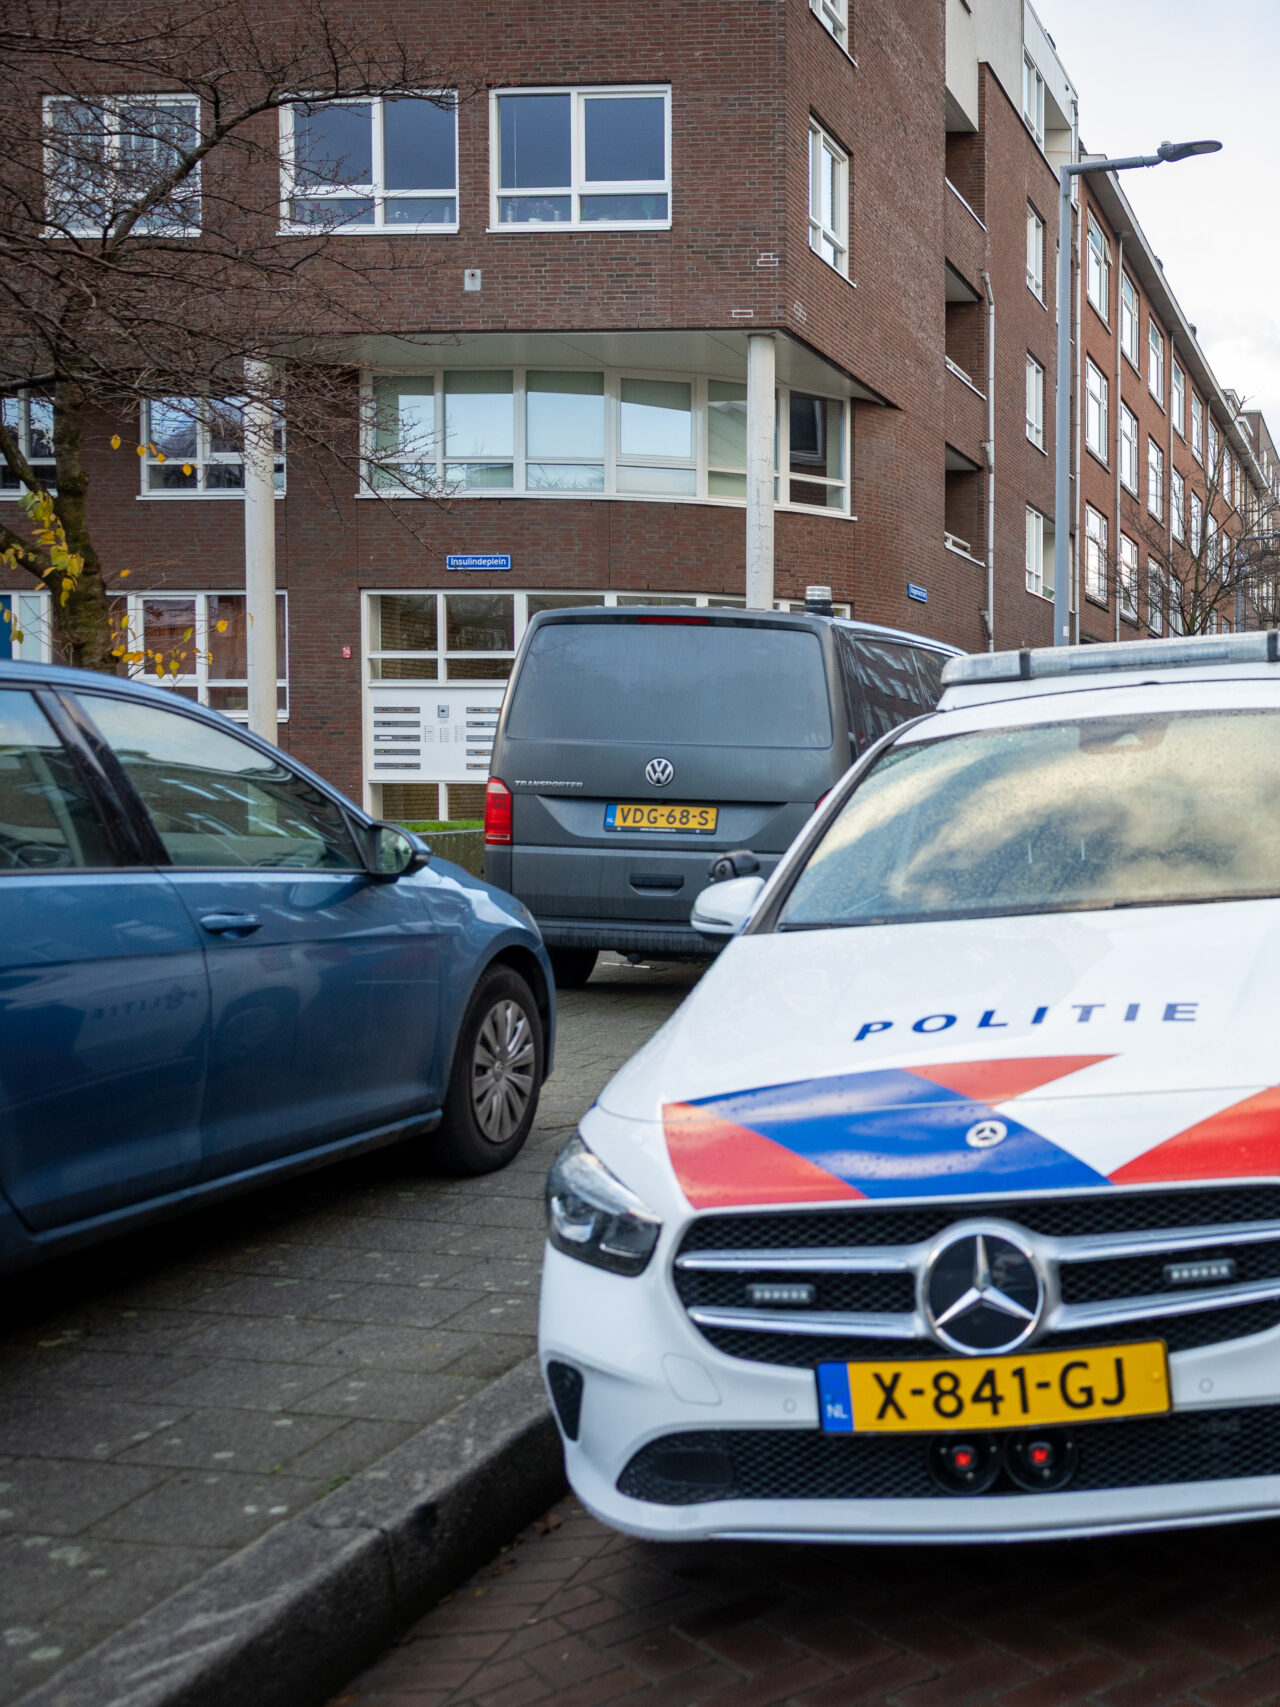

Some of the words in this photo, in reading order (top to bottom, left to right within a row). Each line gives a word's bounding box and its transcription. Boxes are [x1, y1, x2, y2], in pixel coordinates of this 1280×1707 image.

[450, 557, 507, 567] Insulindeplein
[620, 807, 710, 826] VDG-68-S
[853, 1002, 1199, 1042] POLITIE
[827, 1404, 849, 1418] NL
[872, 1357, 1126, 1420] X-841-GJ
